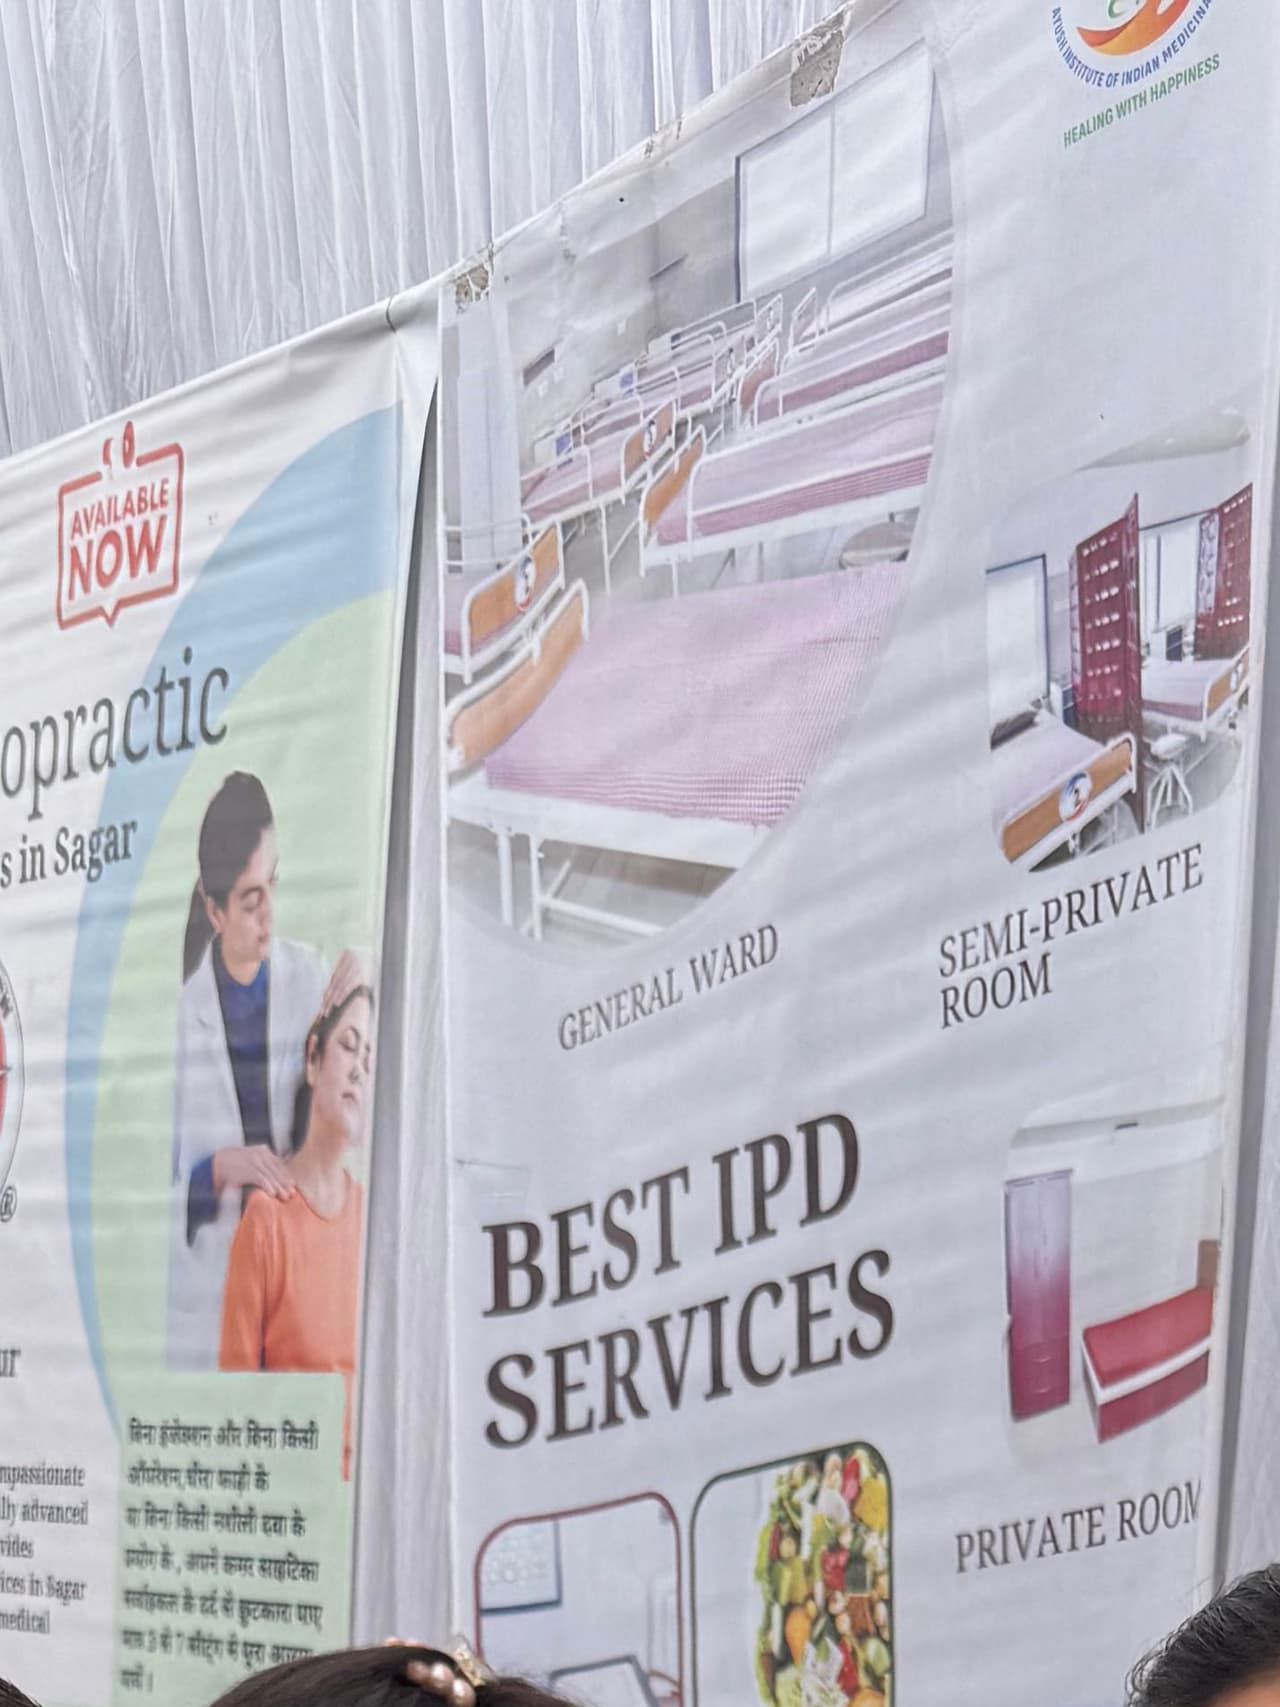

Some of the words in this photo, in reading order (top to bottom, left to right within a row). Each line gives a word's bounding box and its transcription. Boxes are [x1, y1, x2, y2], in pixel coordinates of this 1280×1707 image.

[1052, 7, 1069, 51] AYUSH
[1064, 46, 1105, 87] INSTITUTE
[1105, 73, 1120, 88] OF
[1121, 56, 1160, 87] INDIAN
[1064, 108, 1113, 149] HEALING
[1115, 90, 1148, 119] WITH
[1150, 53, 1221, 102] HAPPINESS
[69, 477, 170, 539] AVAILABLE
[68, 513, 169, 601] NOW
[18, 835, 46, 883] in
[54, 820, 137, 882] Sagar
[938, 844, 1204, 978] SEMI-PRIVATE
[557, 965, 684, 1052] GENERAL
[691, 923, 780, 993] WARD
[940, 955, 1053, 1031] ROOM
[482, 1166, 690, 1319] BEST
[712, 1113, 860, 1257] IPD
[484, 1249, 897, 1451] SERVICES
[20, 1499, 89, 1526] advanced
[955, 1505, 1107, 1574] PRIVATE
[29, 1572, 43, 1597] in
[46, 1575, 87, 1605] Sagar
